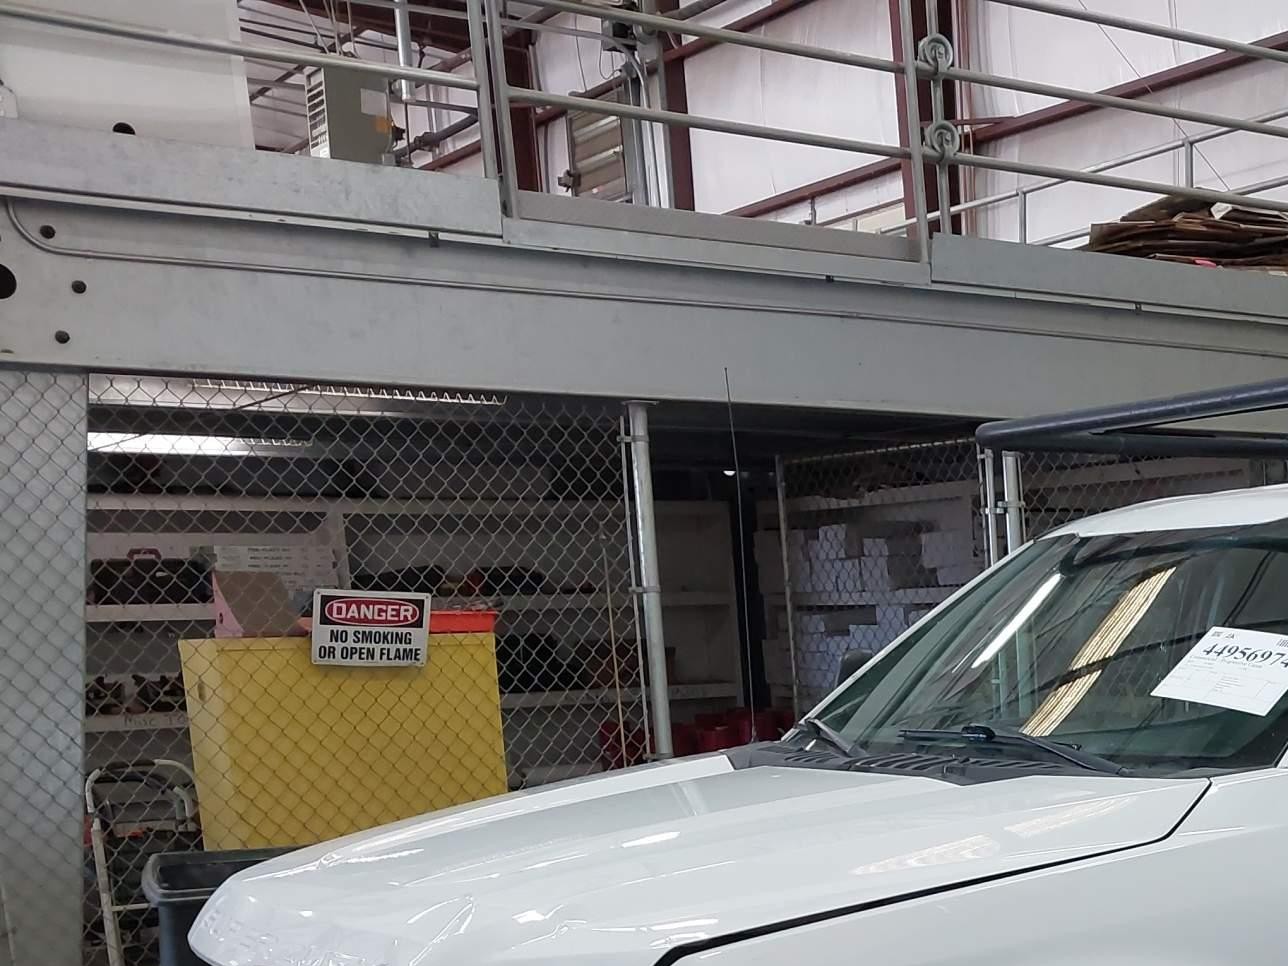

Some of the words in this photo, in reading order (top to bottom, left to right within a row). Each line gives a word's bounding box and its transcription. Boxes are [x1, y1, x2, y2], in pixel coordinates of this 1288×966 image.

[332, 602, 413, 621] DANGER
[329, 629, 348, 643] NO
[352, 630, 412, 645] SMOKING
[318, 645, 336, 660] OR
[340, 646, 375, 661] OPEN
[379, 647, 421, 662] FLAME
